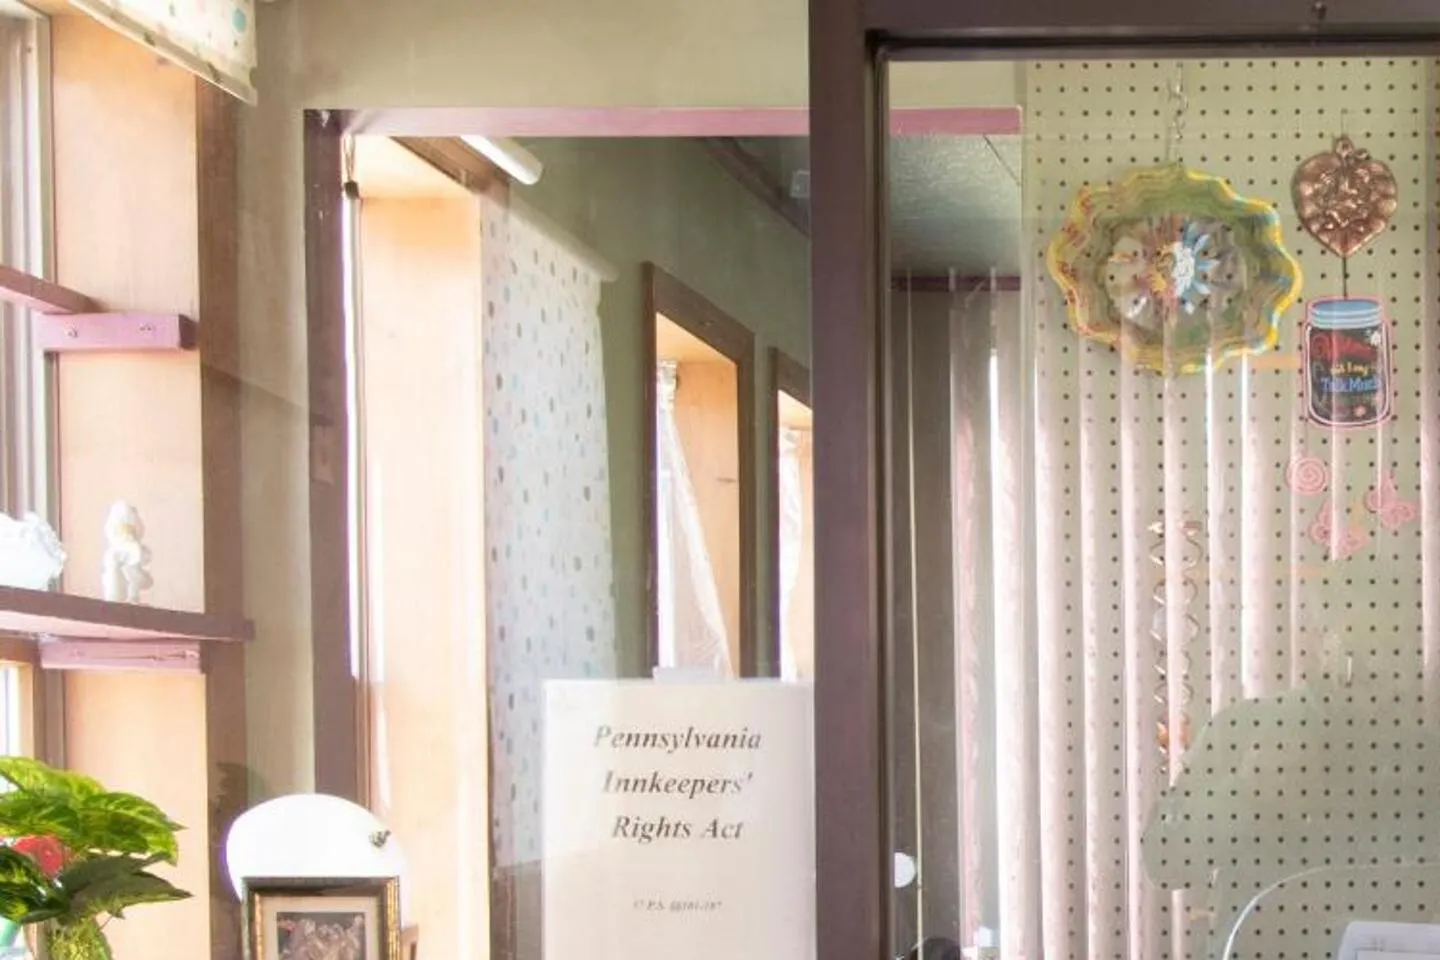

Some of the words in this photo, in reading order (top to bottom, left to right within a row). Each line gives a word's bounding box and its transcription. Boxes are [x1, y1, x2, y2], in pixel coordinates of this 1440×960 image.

[593, 725, 762, 754] Pennsylvania
[602, 770, 754, 800] Innkeepers'
[611, 815, 692, 845] Rights
[700, 817, 744, 840] Act
